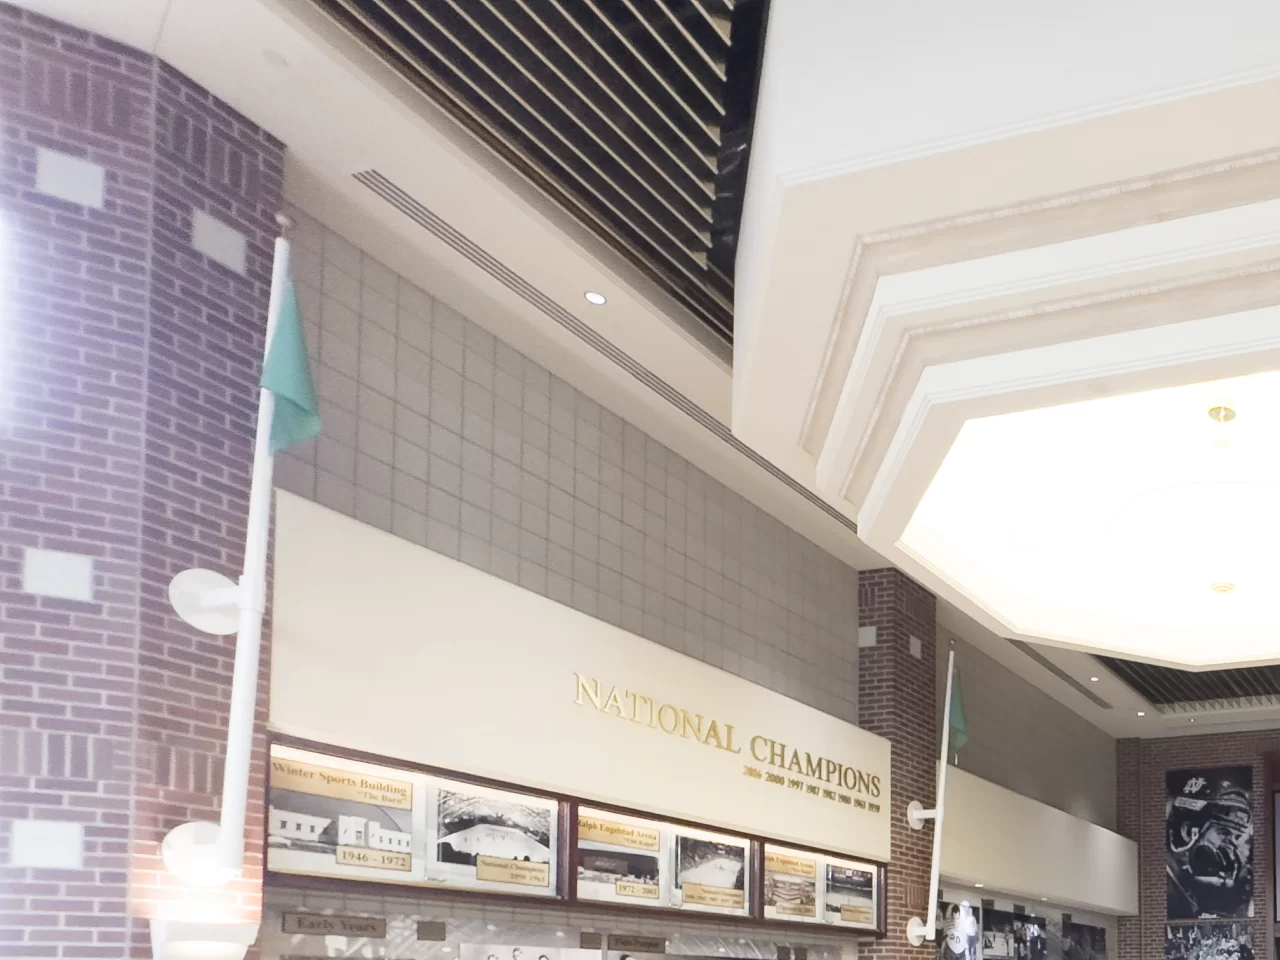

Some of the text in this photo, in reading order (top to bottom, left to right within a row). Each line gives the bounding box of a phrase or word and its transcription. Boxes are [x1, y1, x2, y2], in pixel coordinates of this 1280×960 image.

[573, 672, 880, 798] NATIONAL CHAMPIONS
[272, 762, 408, 800] Winter Sports Building
[341, 851, 369, 862] 1946
[381, 855, 406, 866] 1972
[619, 884, 635, 893] 1972
[297, 917, 333, 932] Early
